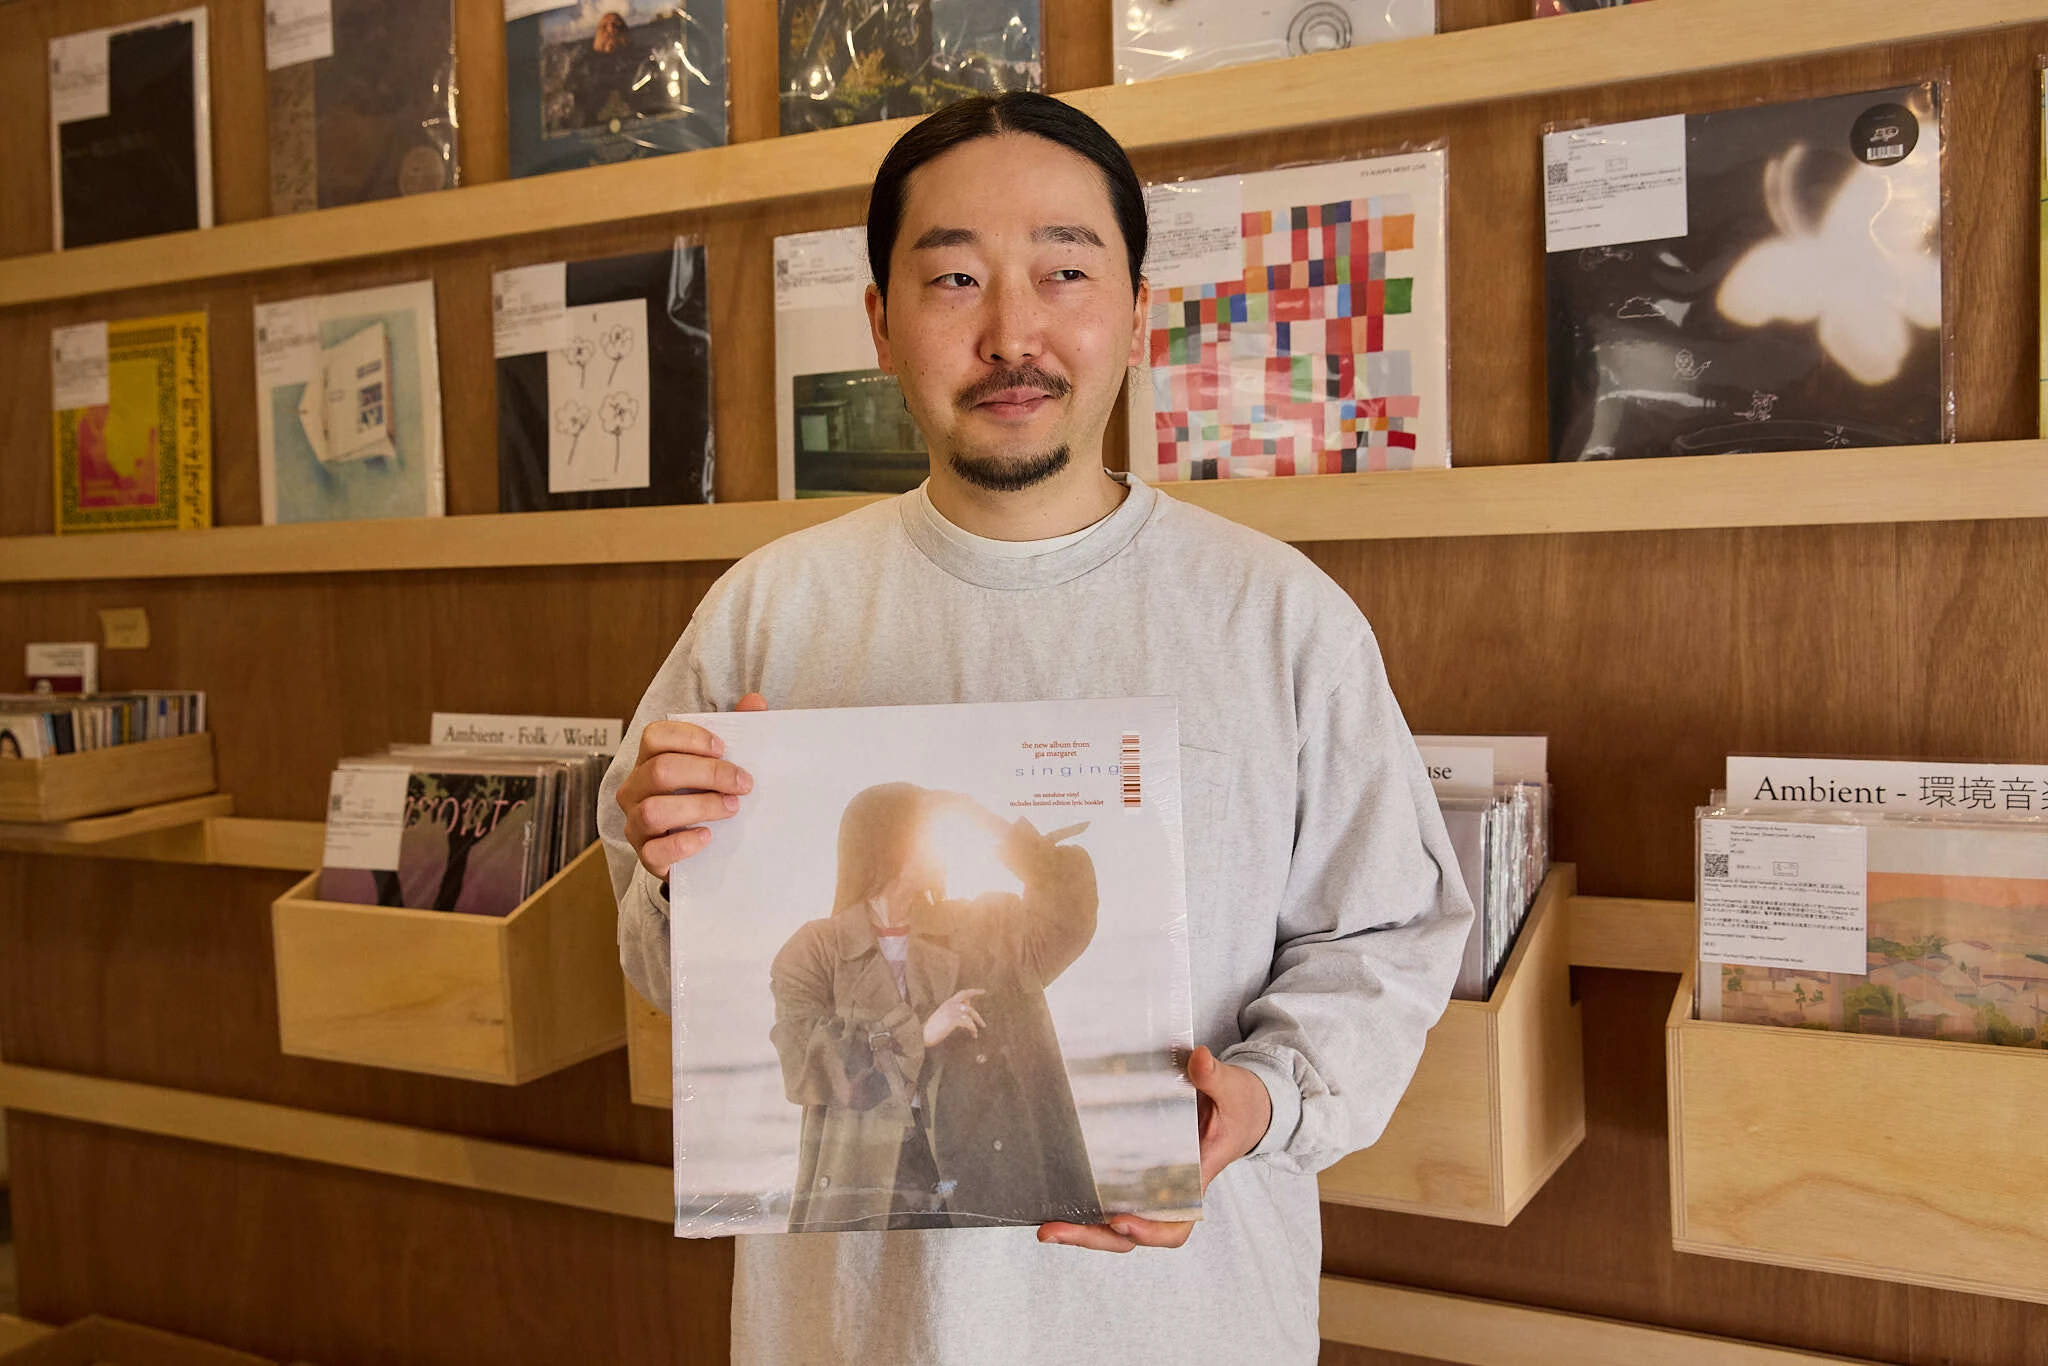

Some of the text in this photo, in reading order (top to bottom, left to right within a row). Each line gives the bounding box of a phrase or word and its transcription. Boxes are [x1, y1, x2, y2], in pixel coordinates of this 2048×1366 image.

[443, 724, 505, 744] Ambient
[518, 726, 548, 745] Folk
[564, 727, 608, 746] World
[1022, 741, 1033, 749] the
[1050, 741, 1071, 749] album
[1072, 740, 1090, 748] from
[1034, 750, 1077, 759] gia margaret
[1016, 764, 1120, 778] singing
[1754, 776, 1887, 804] Ambient
[1920, 776, 2048, 810] 環境音
